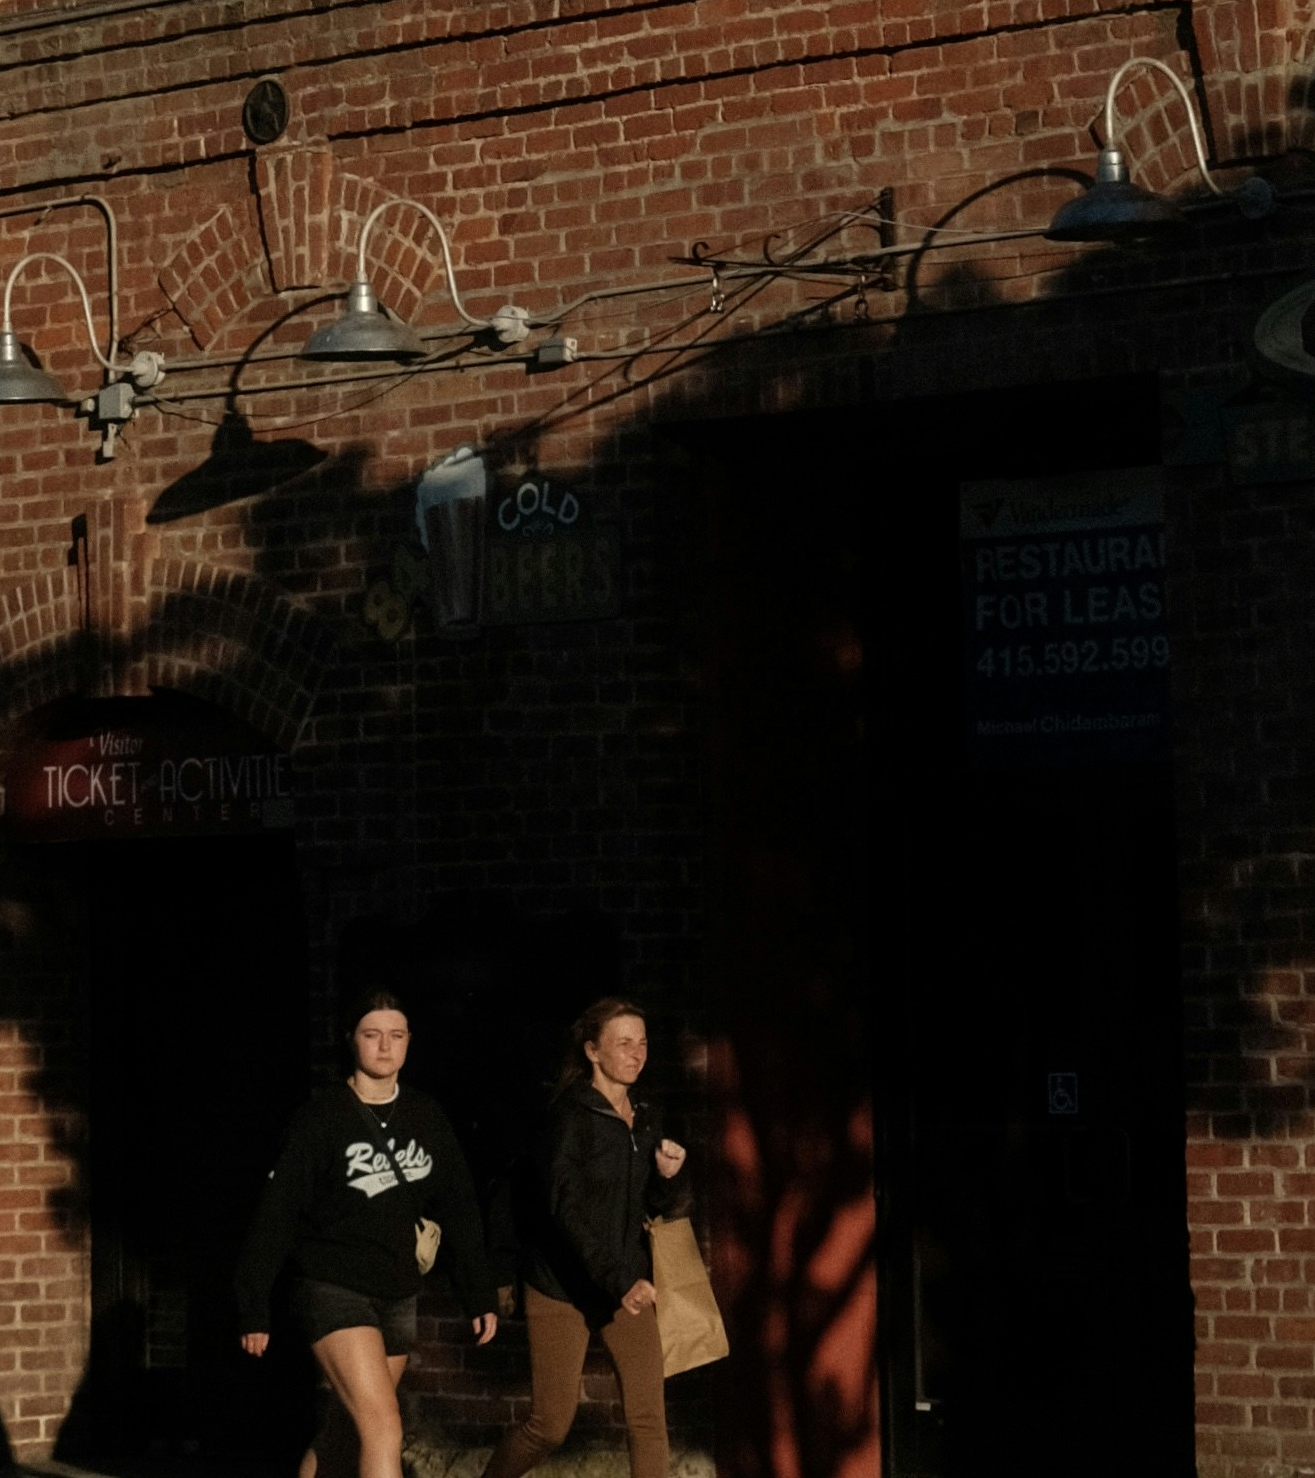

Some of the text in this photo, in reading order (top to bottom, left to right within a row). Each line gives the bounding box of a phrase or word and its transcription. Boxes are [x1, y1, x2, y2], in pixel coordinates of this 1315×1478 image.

[497, 480, 581, 532] COLD
[490, 536, 613, 612] BEERS
[975, 581, 1164, 632] FOR LEAS
[975, 634, 1171, 679] 415.592.599
[90, 726, 145, 757] Visitor
[42, 761, 142, 809] TICKET
[158, 753, 291, 804] ACTIVITIE
[103, 801, 263, 828] CENTER
